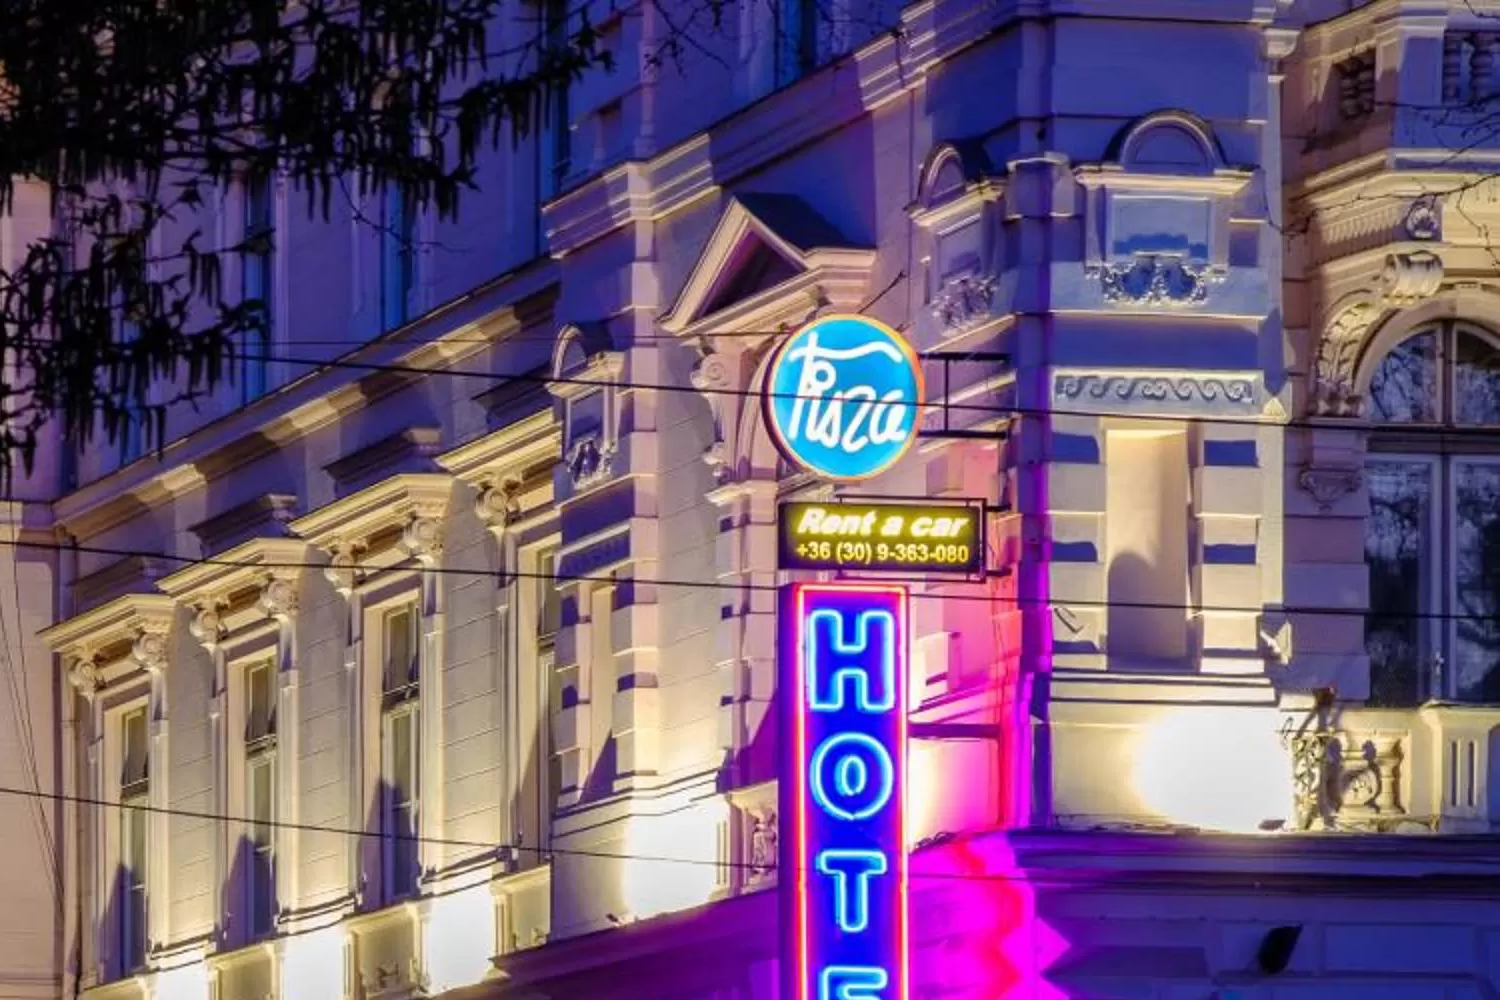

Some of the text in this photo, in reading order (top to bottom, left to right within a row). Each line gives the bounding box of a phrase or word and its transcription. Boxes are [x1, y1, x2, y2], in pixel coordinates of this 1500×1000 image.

[797, 507, 970, 538] Rent a car
[796, 541, 831, 560] +36
[835, 542, 872, 565] (30)
